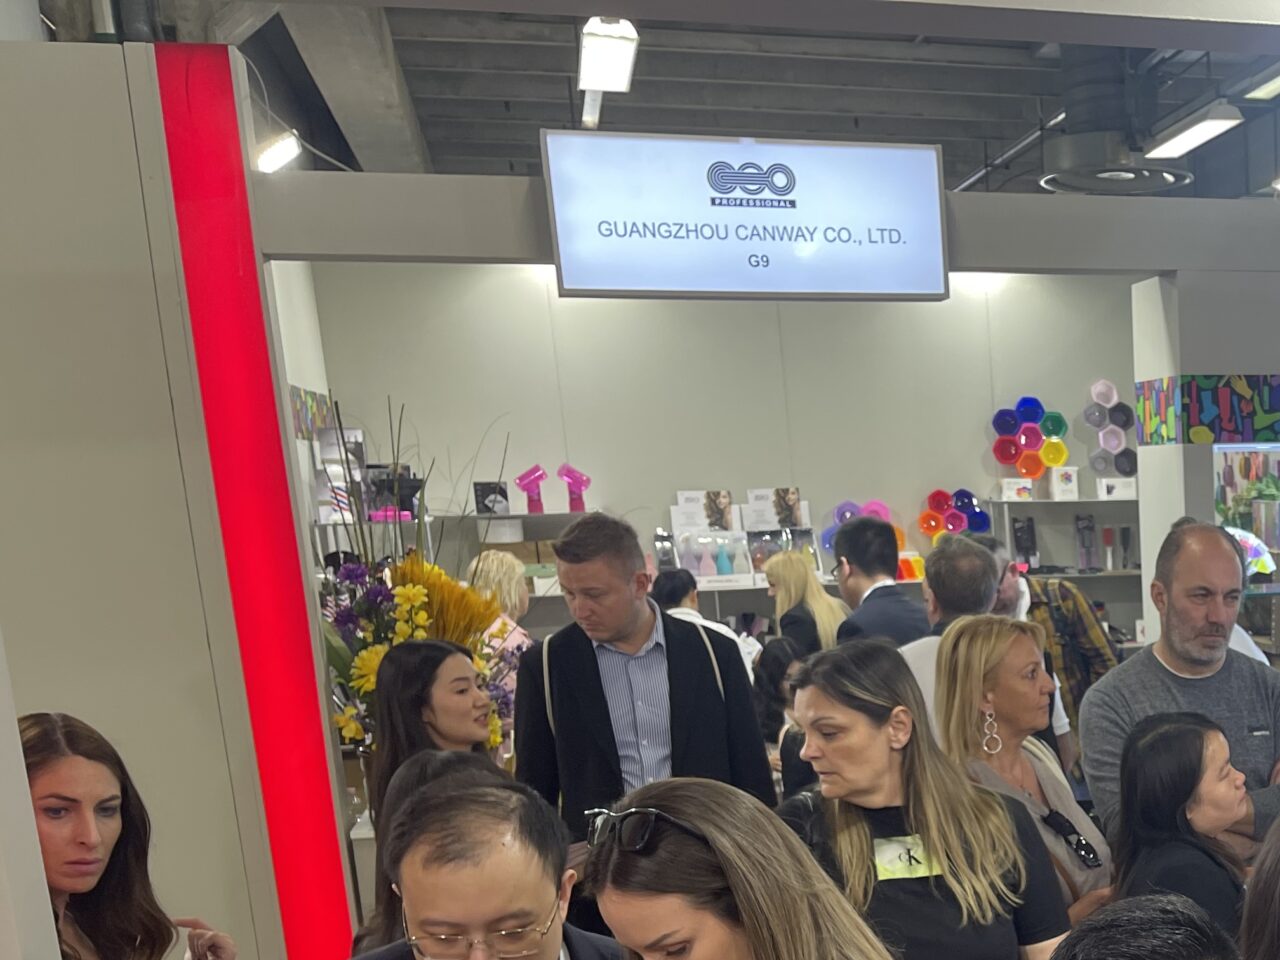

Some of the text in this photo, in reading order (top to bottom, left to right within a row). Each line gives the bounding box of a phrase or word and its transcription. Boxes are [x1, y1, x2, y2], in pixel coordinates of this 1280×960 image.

[714, 197, 793, 208] PROFESSIONAL
[598, 220, 907, 246] GUANGZHOU CANWAY CO., LTD.
[748, 254, 770, 268] G9
